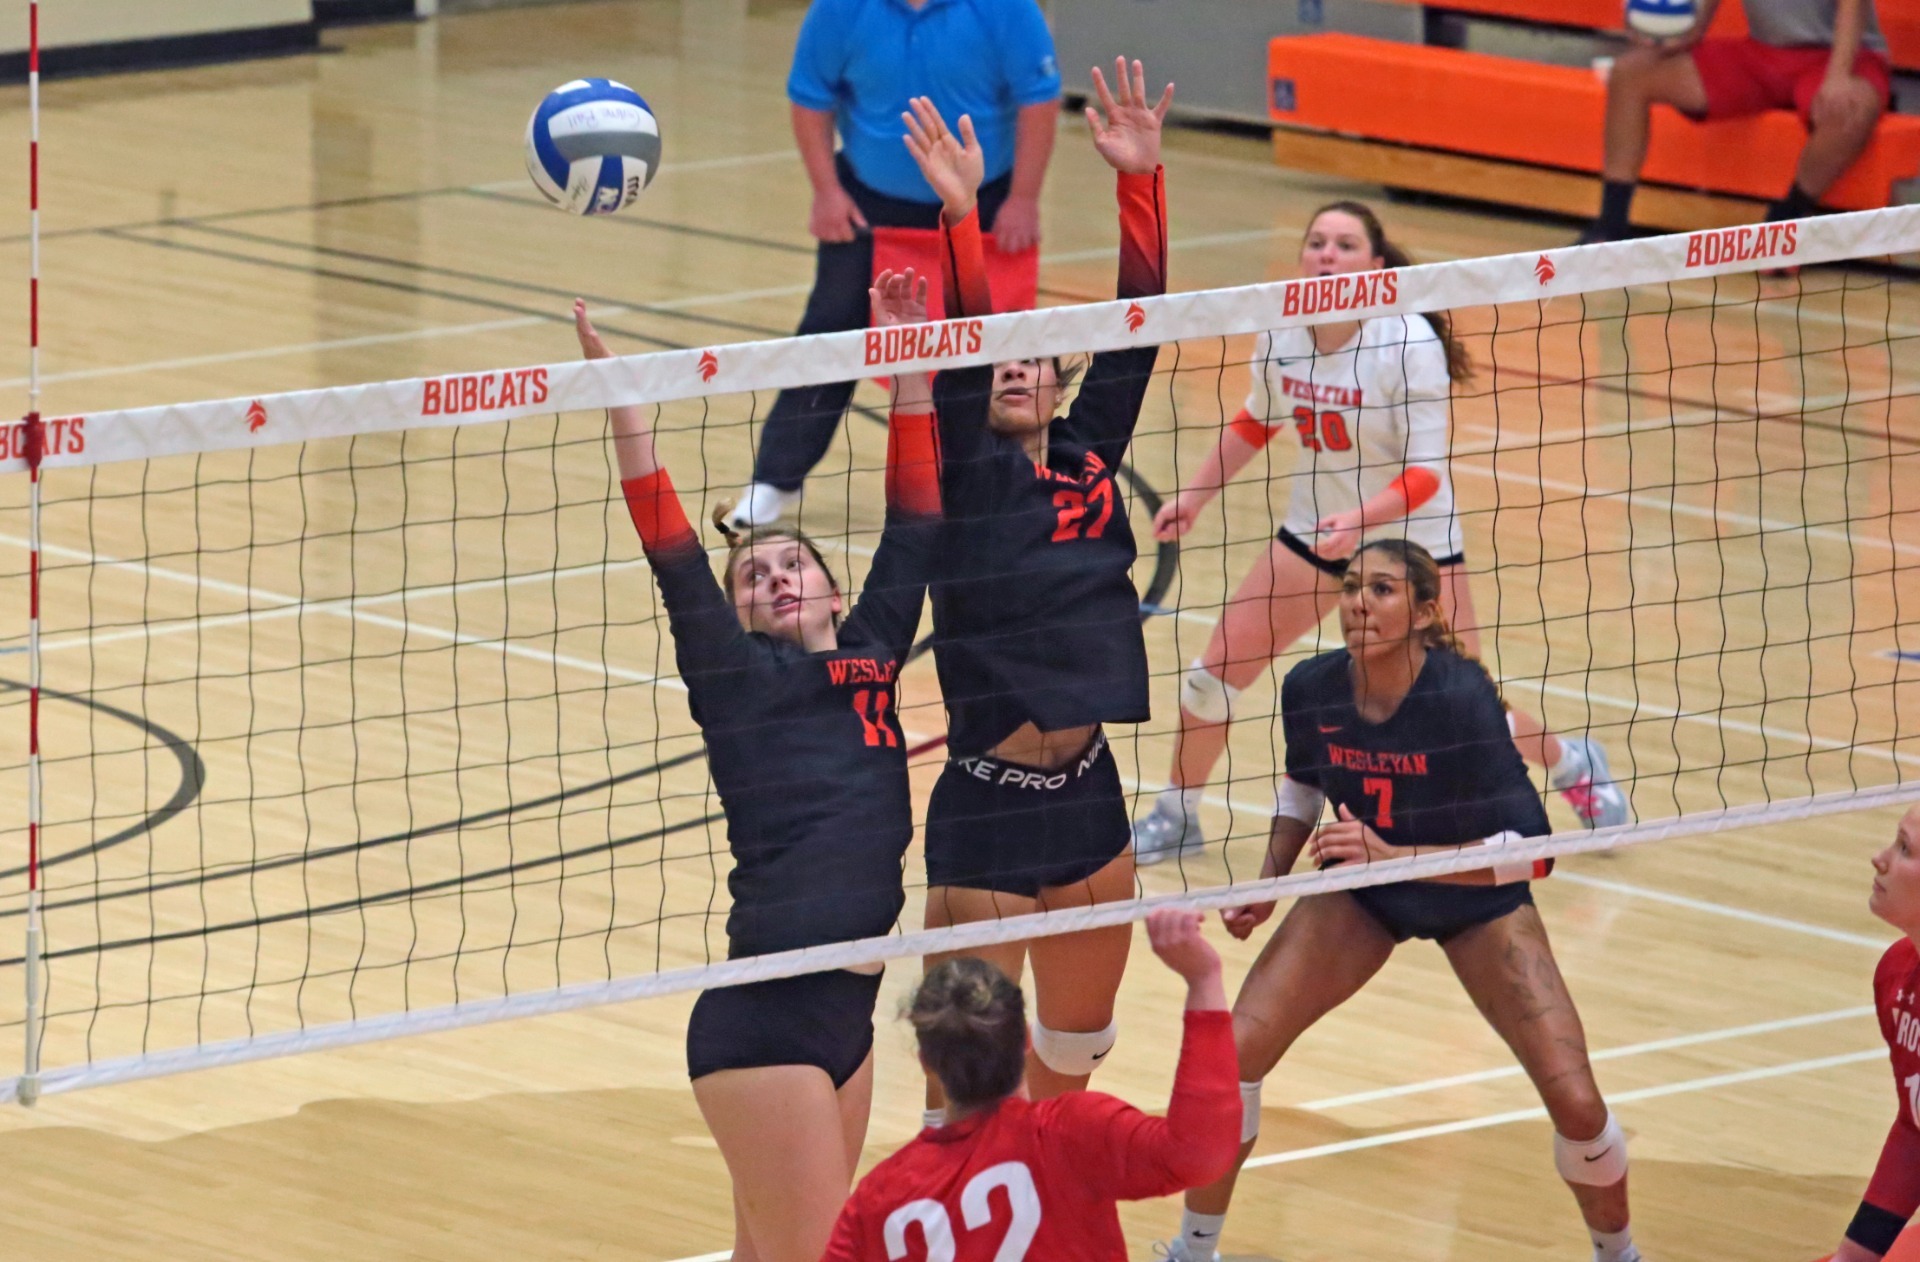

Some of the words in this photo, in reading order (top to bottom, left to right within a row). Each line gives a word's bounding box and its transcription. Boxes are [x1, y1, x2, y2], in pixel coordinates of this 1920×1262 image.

[421, 368, 548, 416] BOBCATS
[864, 319, 983, 366] BOBCATS
[1282, 271, 1398, 317] BOBCATS
[1685, 222, 1797, 268] BOBCATS
[1293, 405, 1353, 453] 20
[1052, 478, 1113, 542] 27
[853, 690, 897, 748] 11
[998, 768, 1067, 790] PRO
[1327, 743, 1428, 775] WESLEYAN
[1363, 777, 1394, 829] 7
